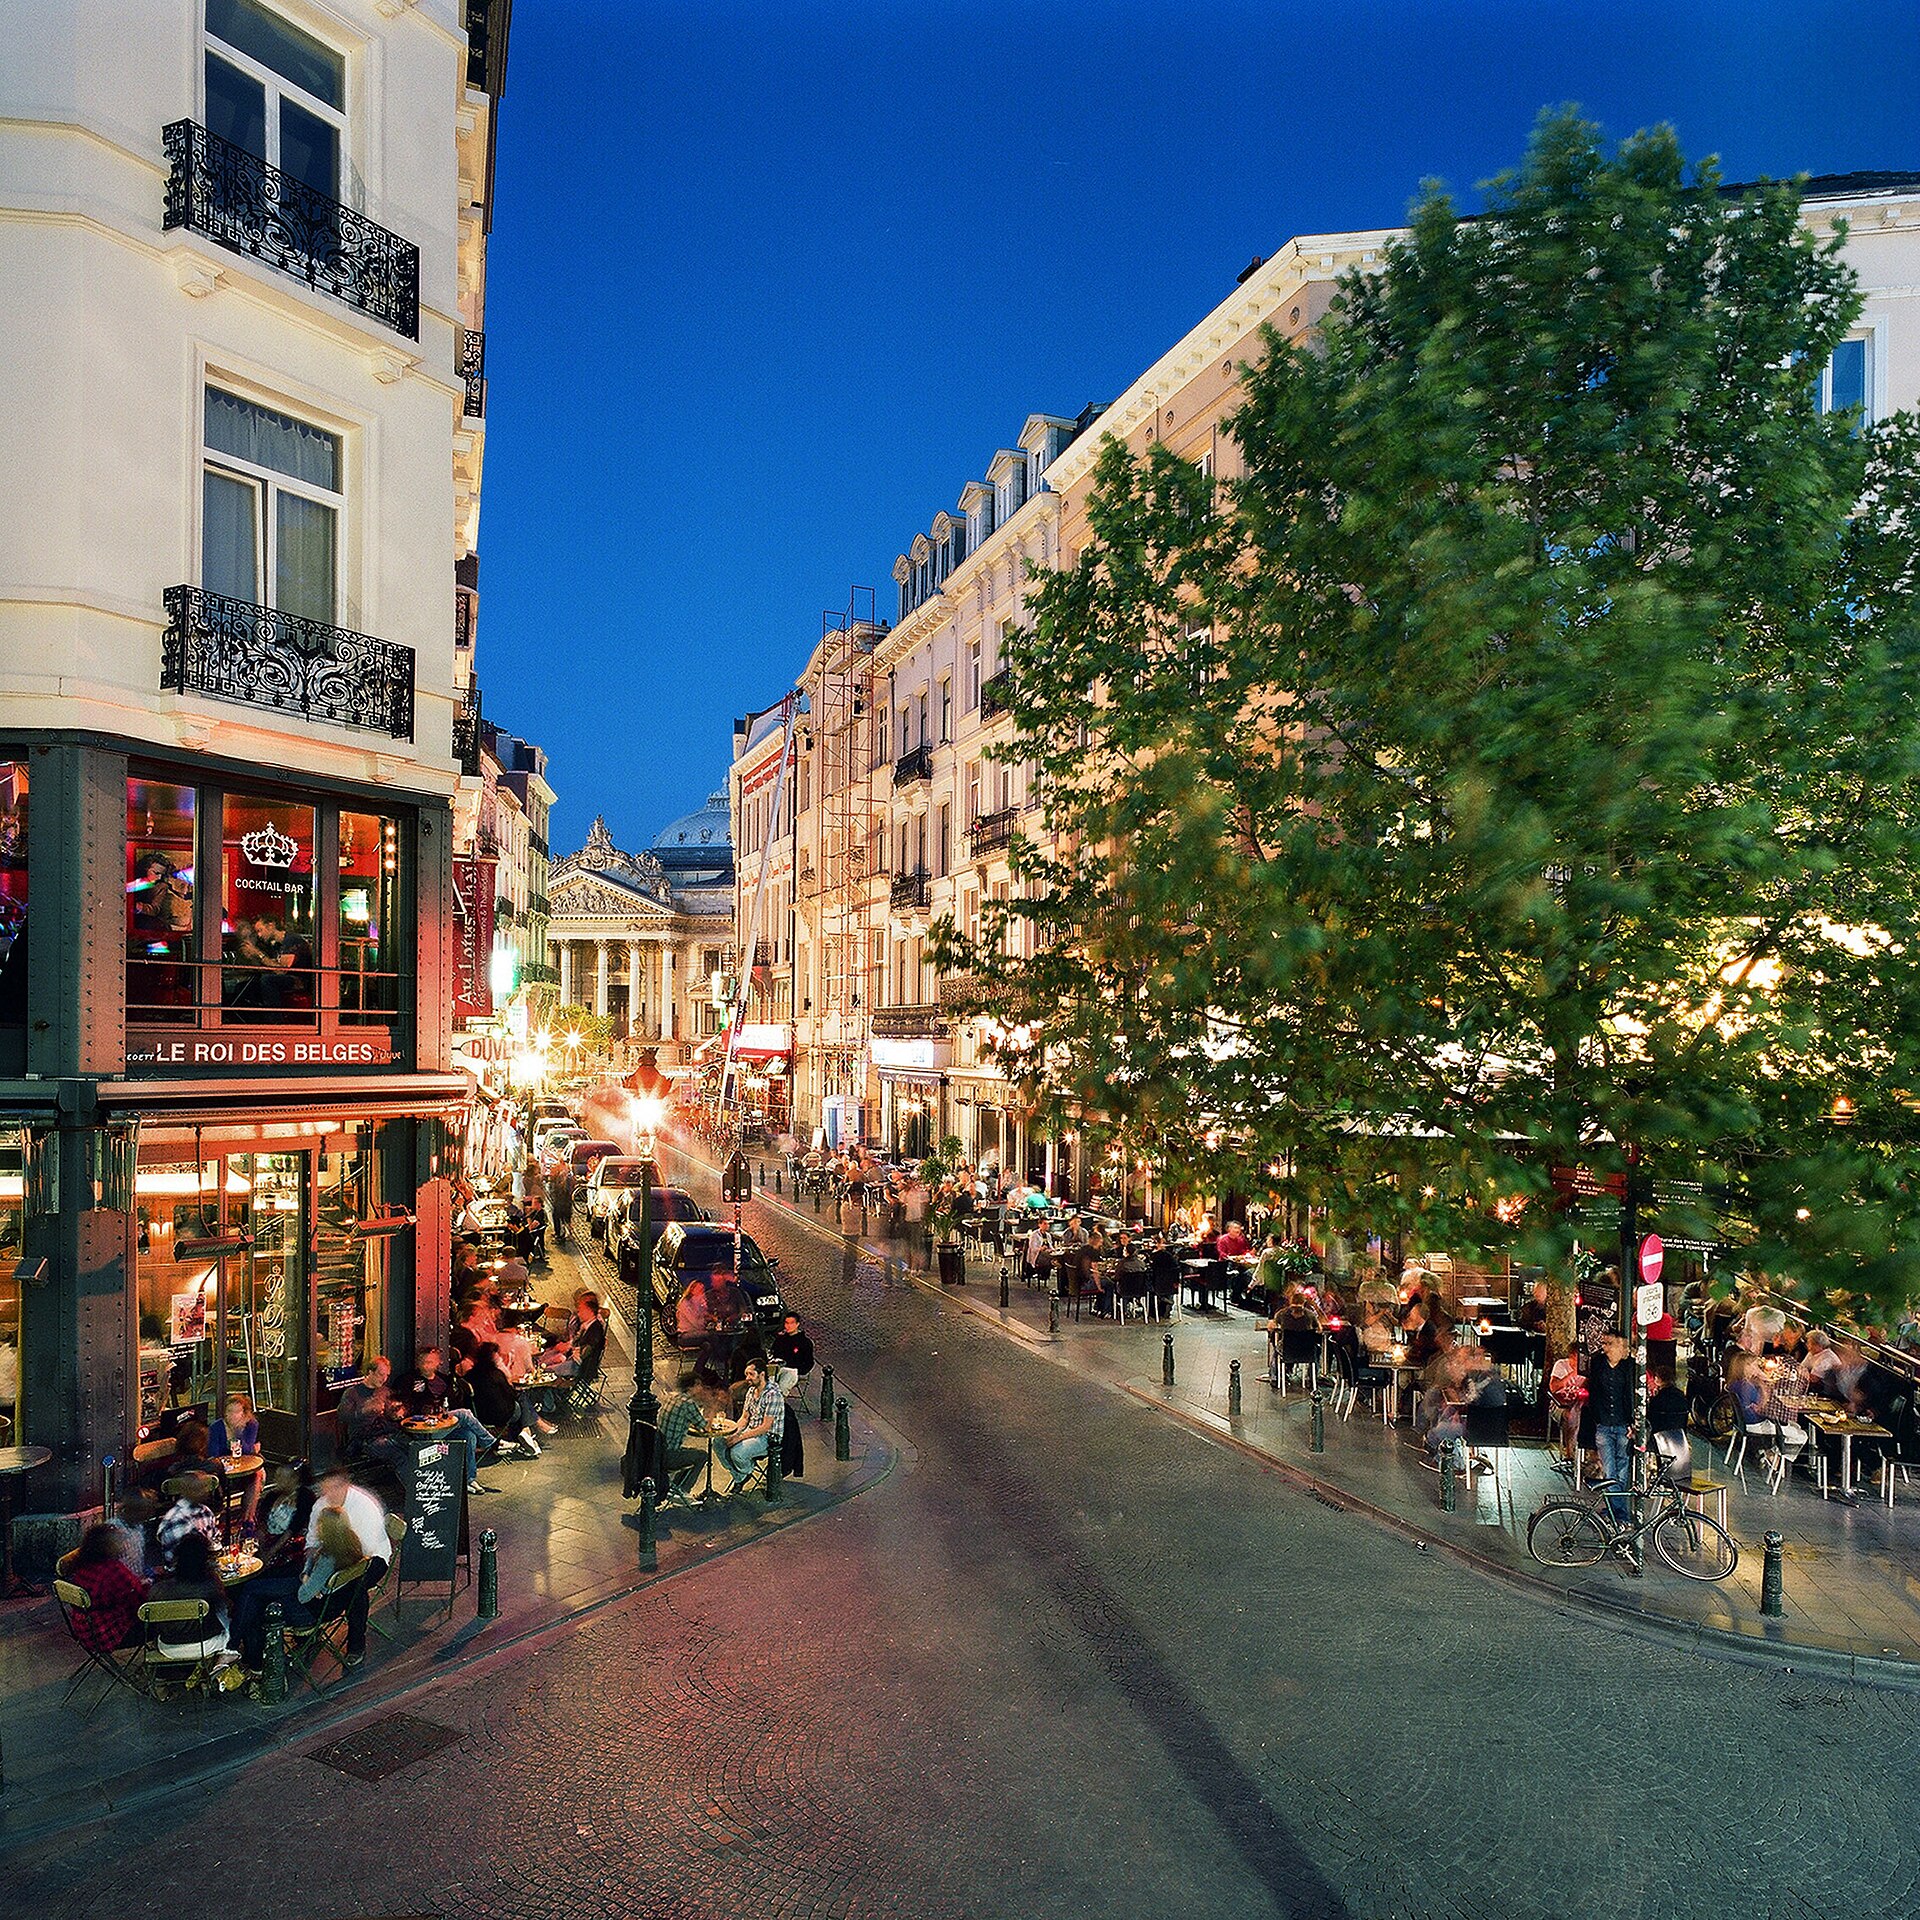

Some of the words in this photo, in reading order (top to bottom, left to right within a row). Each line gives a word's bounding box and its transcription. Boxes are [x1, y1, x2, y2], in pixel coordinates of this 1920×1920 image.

[235, 878, 282, 892] COCKTAIL
[284, 883, 304, 894] BAR
[457, 975, 476, 1007] Au
[156, 1042, 185, 1062] LE
[194, 1042, 234, 1062] ROI
[242, 1042, 286, 1062] DES
[293, 1042, 373, 1062] BELGES
